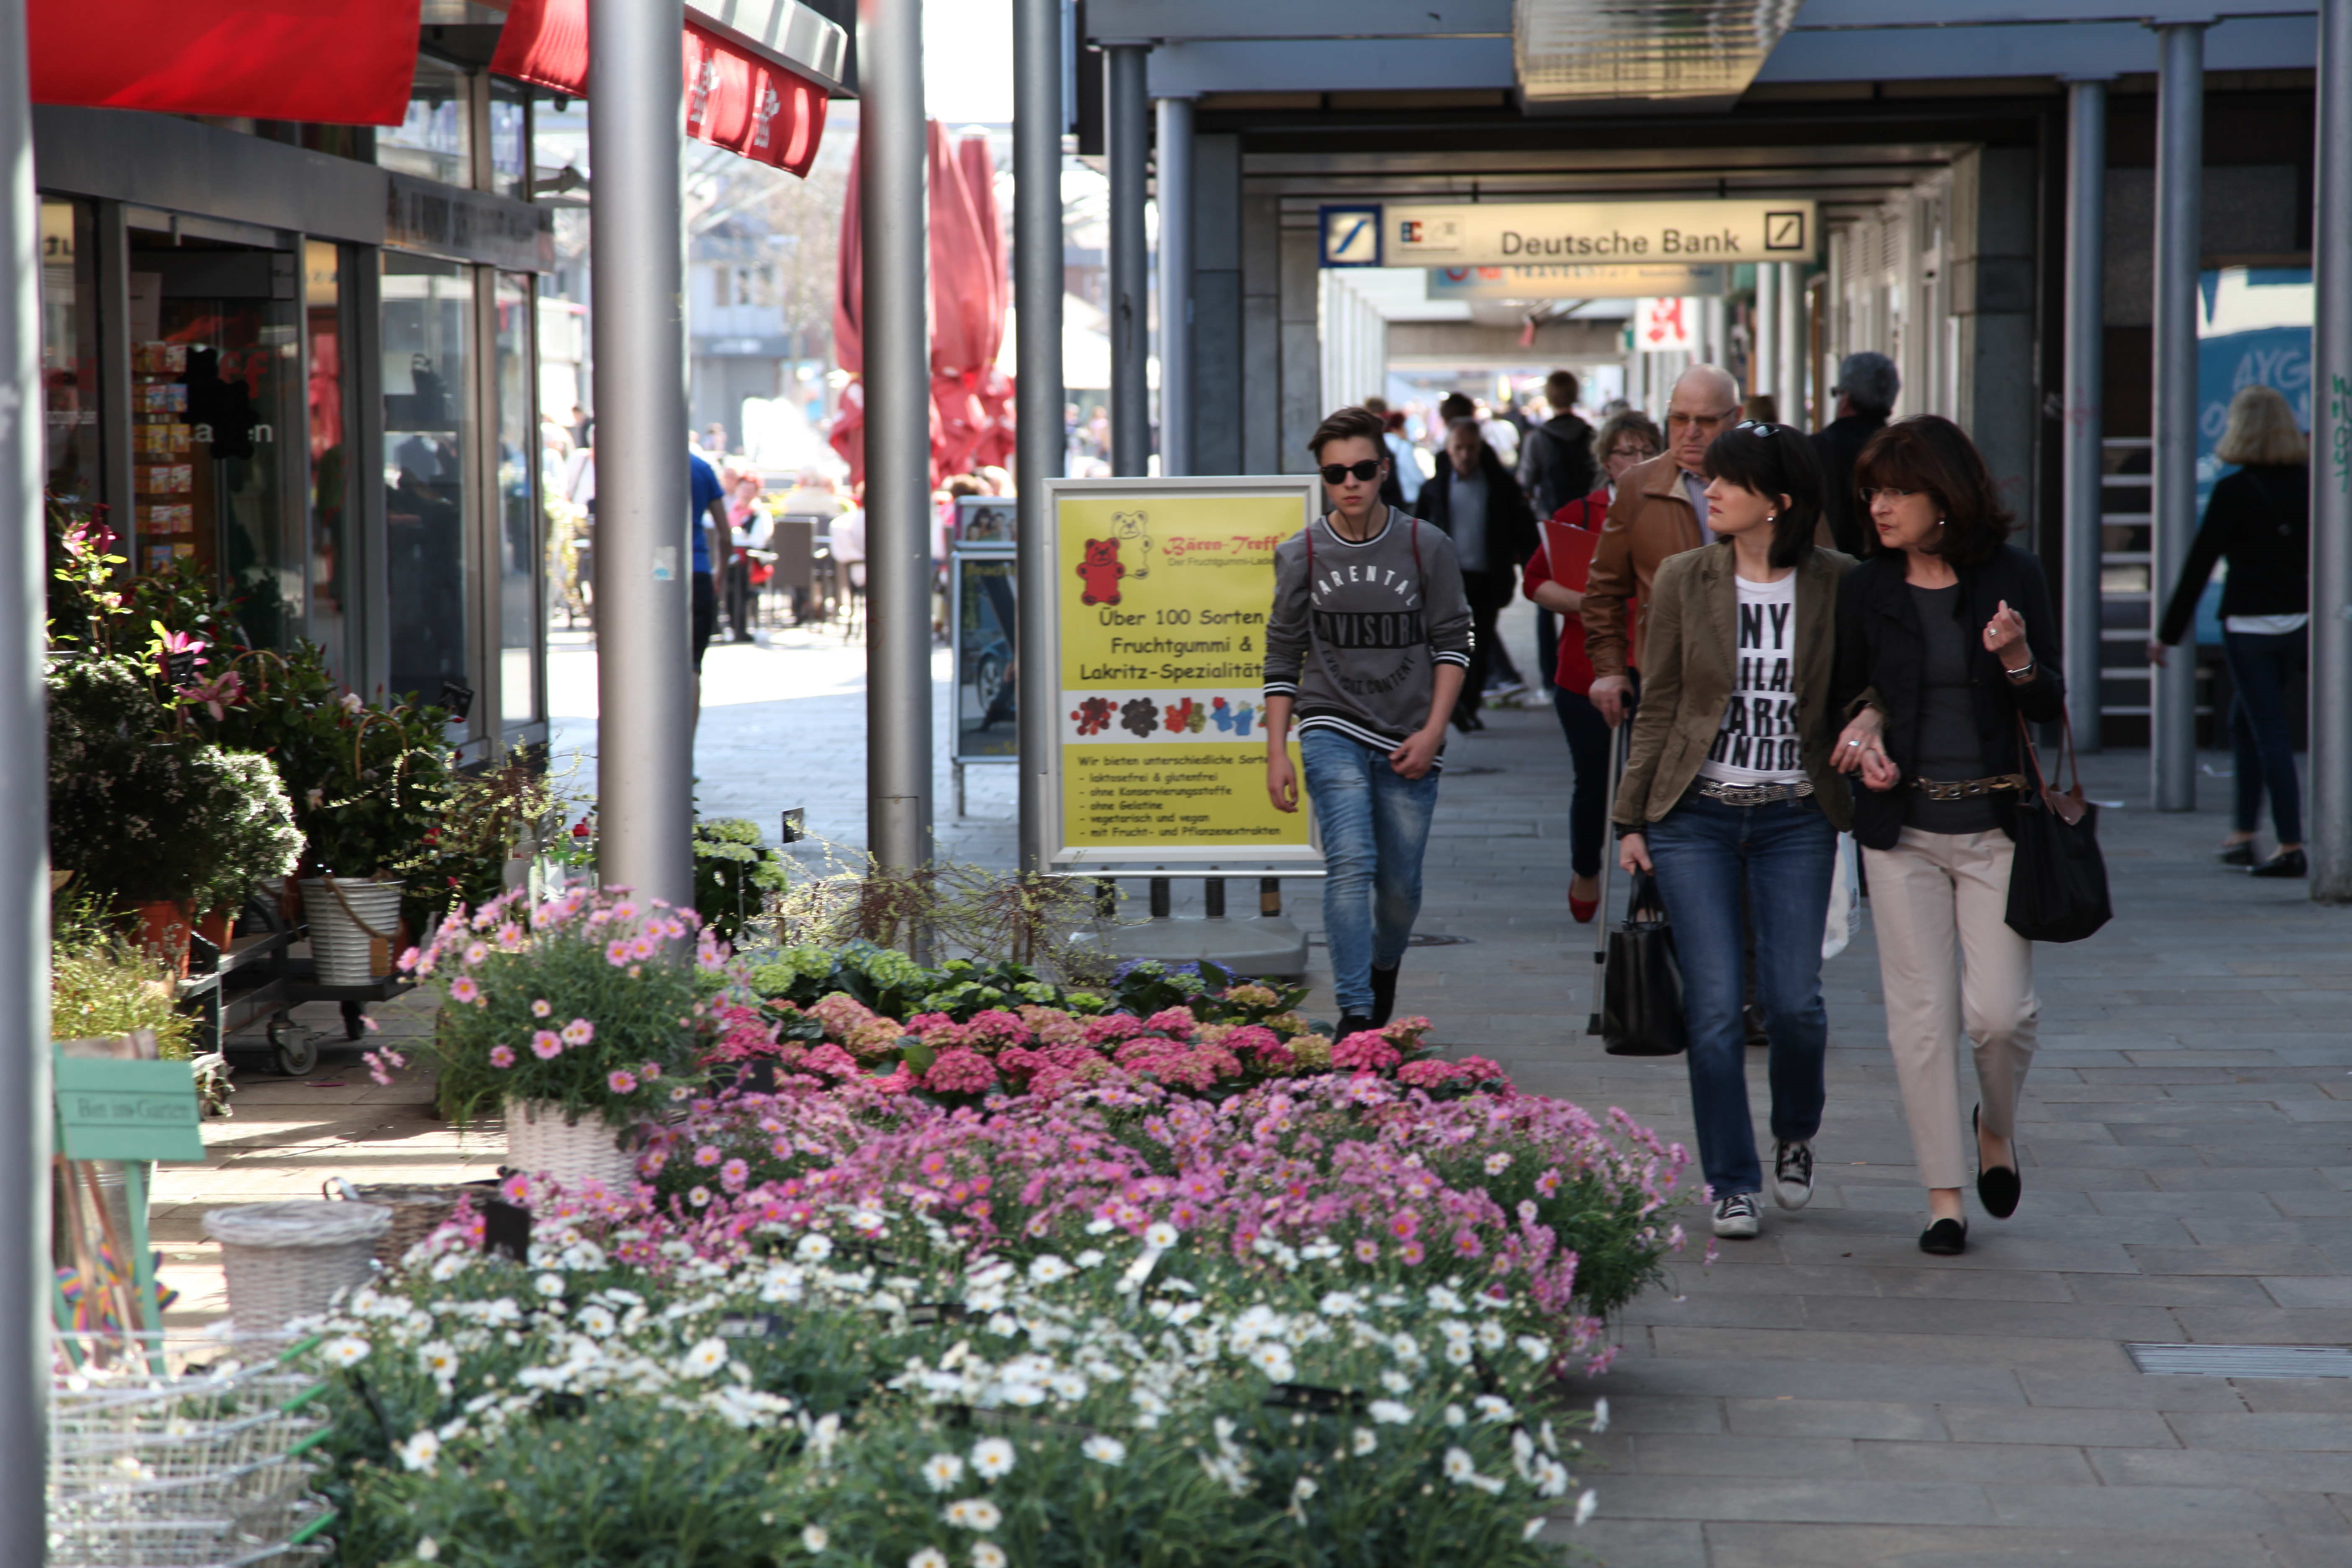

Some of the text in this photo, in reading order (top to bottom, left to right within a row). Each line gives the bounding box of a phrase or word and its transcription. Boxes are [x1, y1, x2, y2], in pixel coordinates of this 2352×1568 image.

[1502, 229, 1741, 255] Deutsche Bank
[1187, 557, 1274, 568] Fruchtgummi-Lade
[1099, 606, 1264, 626] Über 100 Sorten
[1740, 603, 1791, 650] NY
[1111, 636, 1253, 658] Fruchtgummi &
[1080, 661, 1263, 683] Lakritz-Spezialität
[1078, 755, 1269, 766] Wir bieten unterschiedliche Sorte
[1089, 773, 1148, 782] laktosefrei
[1165, 772, 1218, 784] glutenfrei
[1090, 786, 1233, 798] ohne Konservierungsstoffe
[1090, 800, 1163, 810] ohne Gelatine
[1090, 813, 1209, 825] vegetarisch und vegan
[1090, 828, 1108, 837] mit
[1158, 826, 1179, 836] und
[1181, 826, 1281, 836] Pflanzenextrakten
